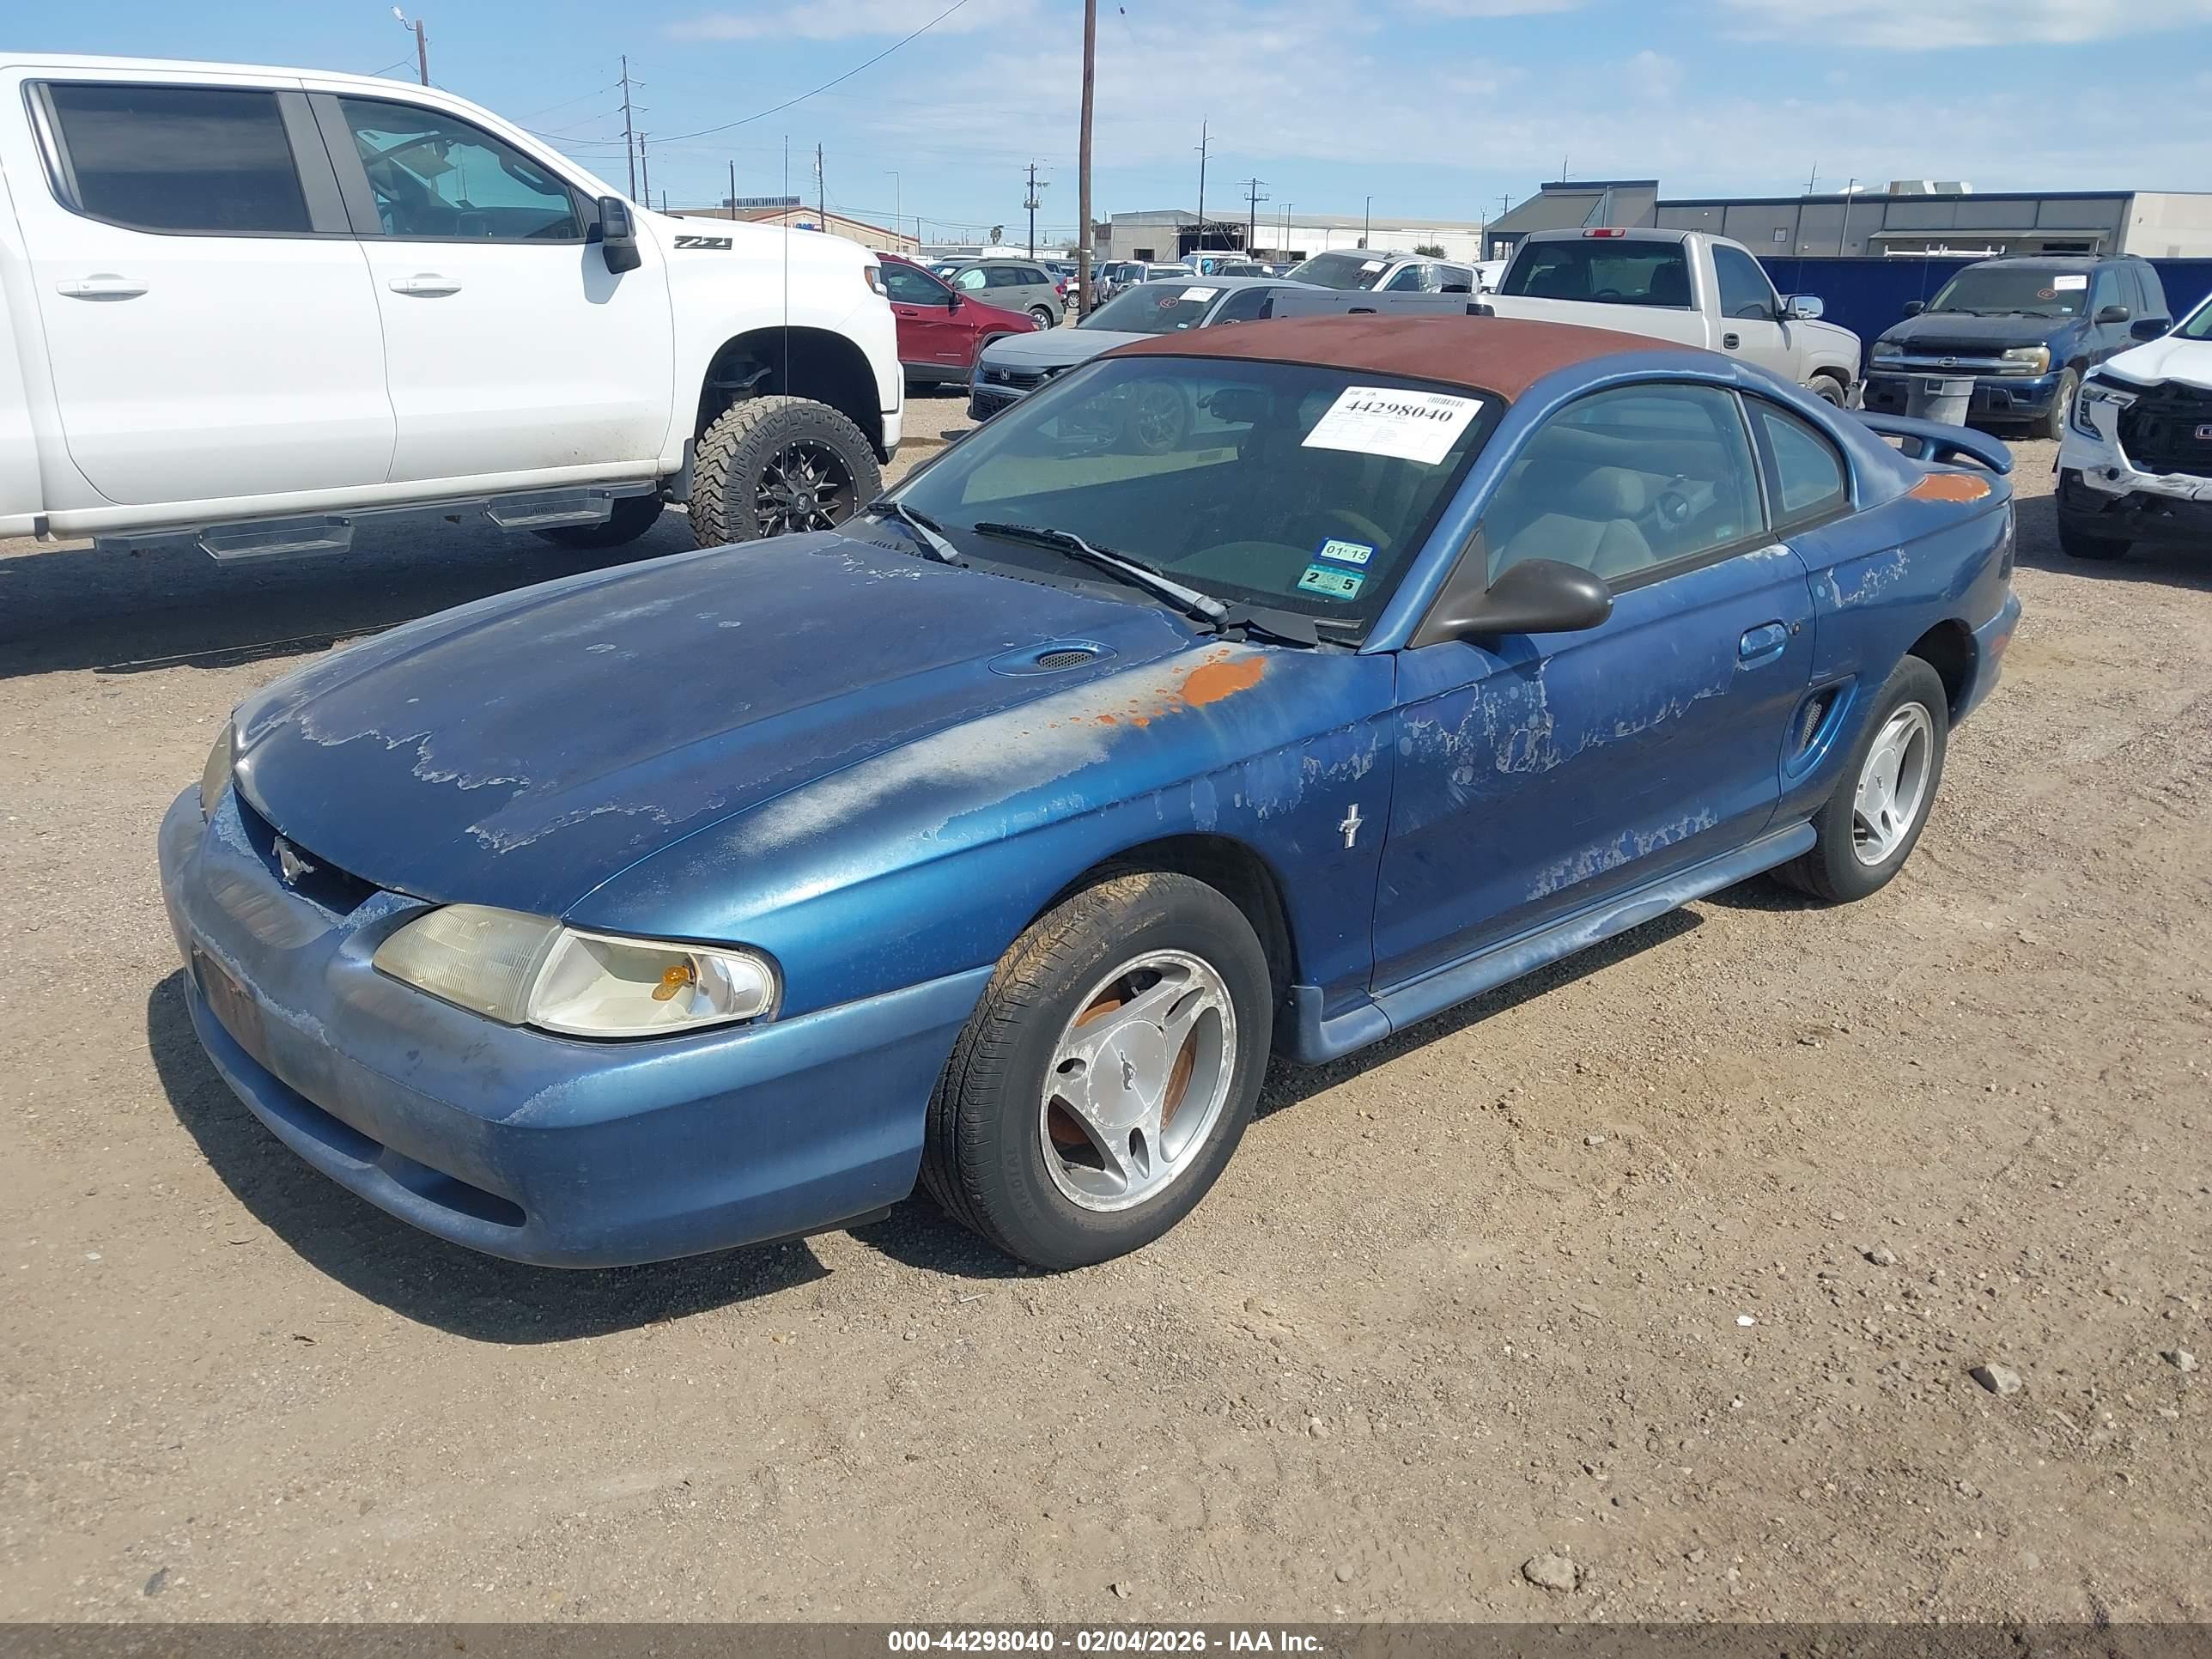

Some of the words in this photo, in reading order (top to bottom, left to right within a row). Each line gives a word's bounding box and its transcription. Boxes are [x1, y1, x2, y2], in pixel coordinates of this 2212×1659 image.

[674, 235, 732, 250] Z71
[1346, 400, 1453, 422] 44298040
[1305, 572, 1320, 583] 2
[1342, 578, 1355, 590] 5
